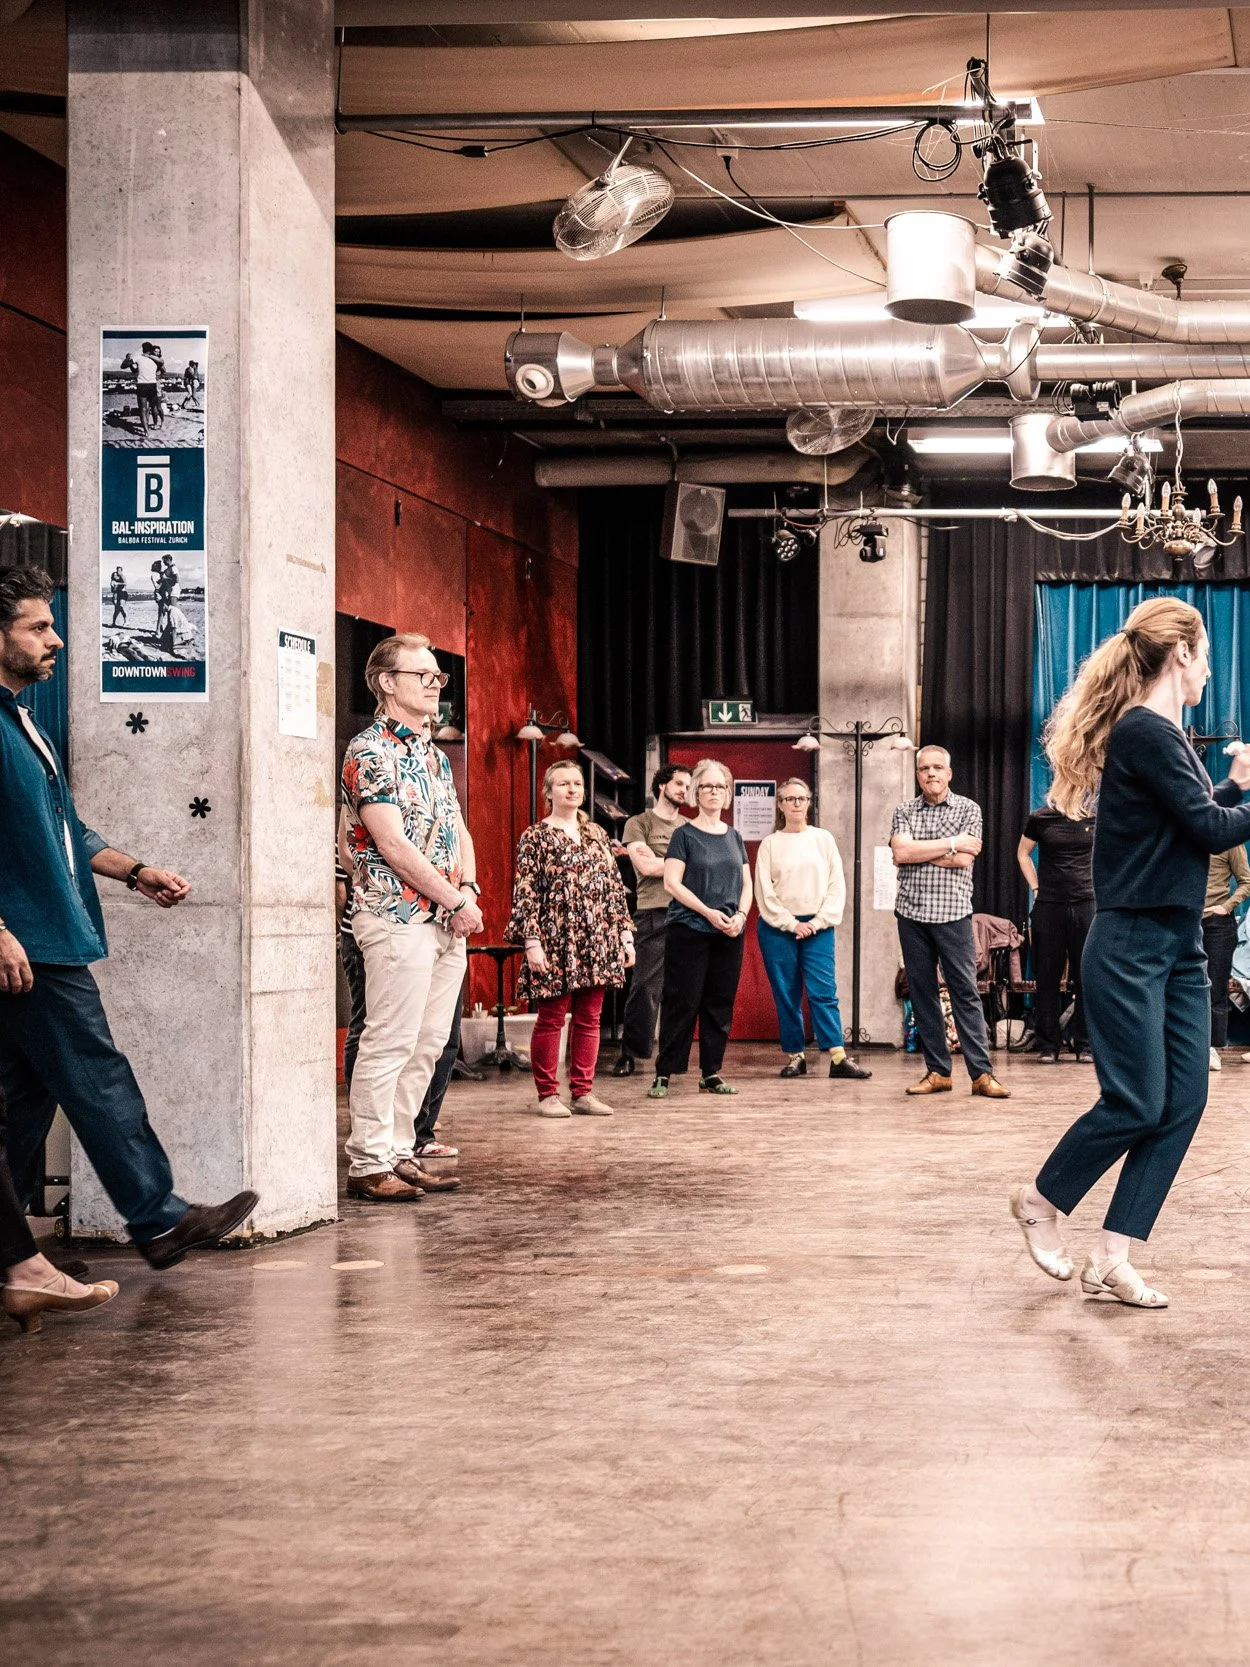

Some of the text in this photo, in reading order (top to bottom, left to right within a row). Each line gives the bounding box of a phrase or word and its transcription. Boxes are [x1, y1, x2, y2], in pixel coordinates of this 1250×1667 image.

[144, 472, 164, 513] B
[112, 520, 195, 534] BAL-INSPIRATION
[118, 536, 140, 544] BALBOA
[141, 536, 167, 544] FESTIVAL
[285, 634, 311, 653] SCHEDULE
[740, 786, 770, 797] SUNDAY
